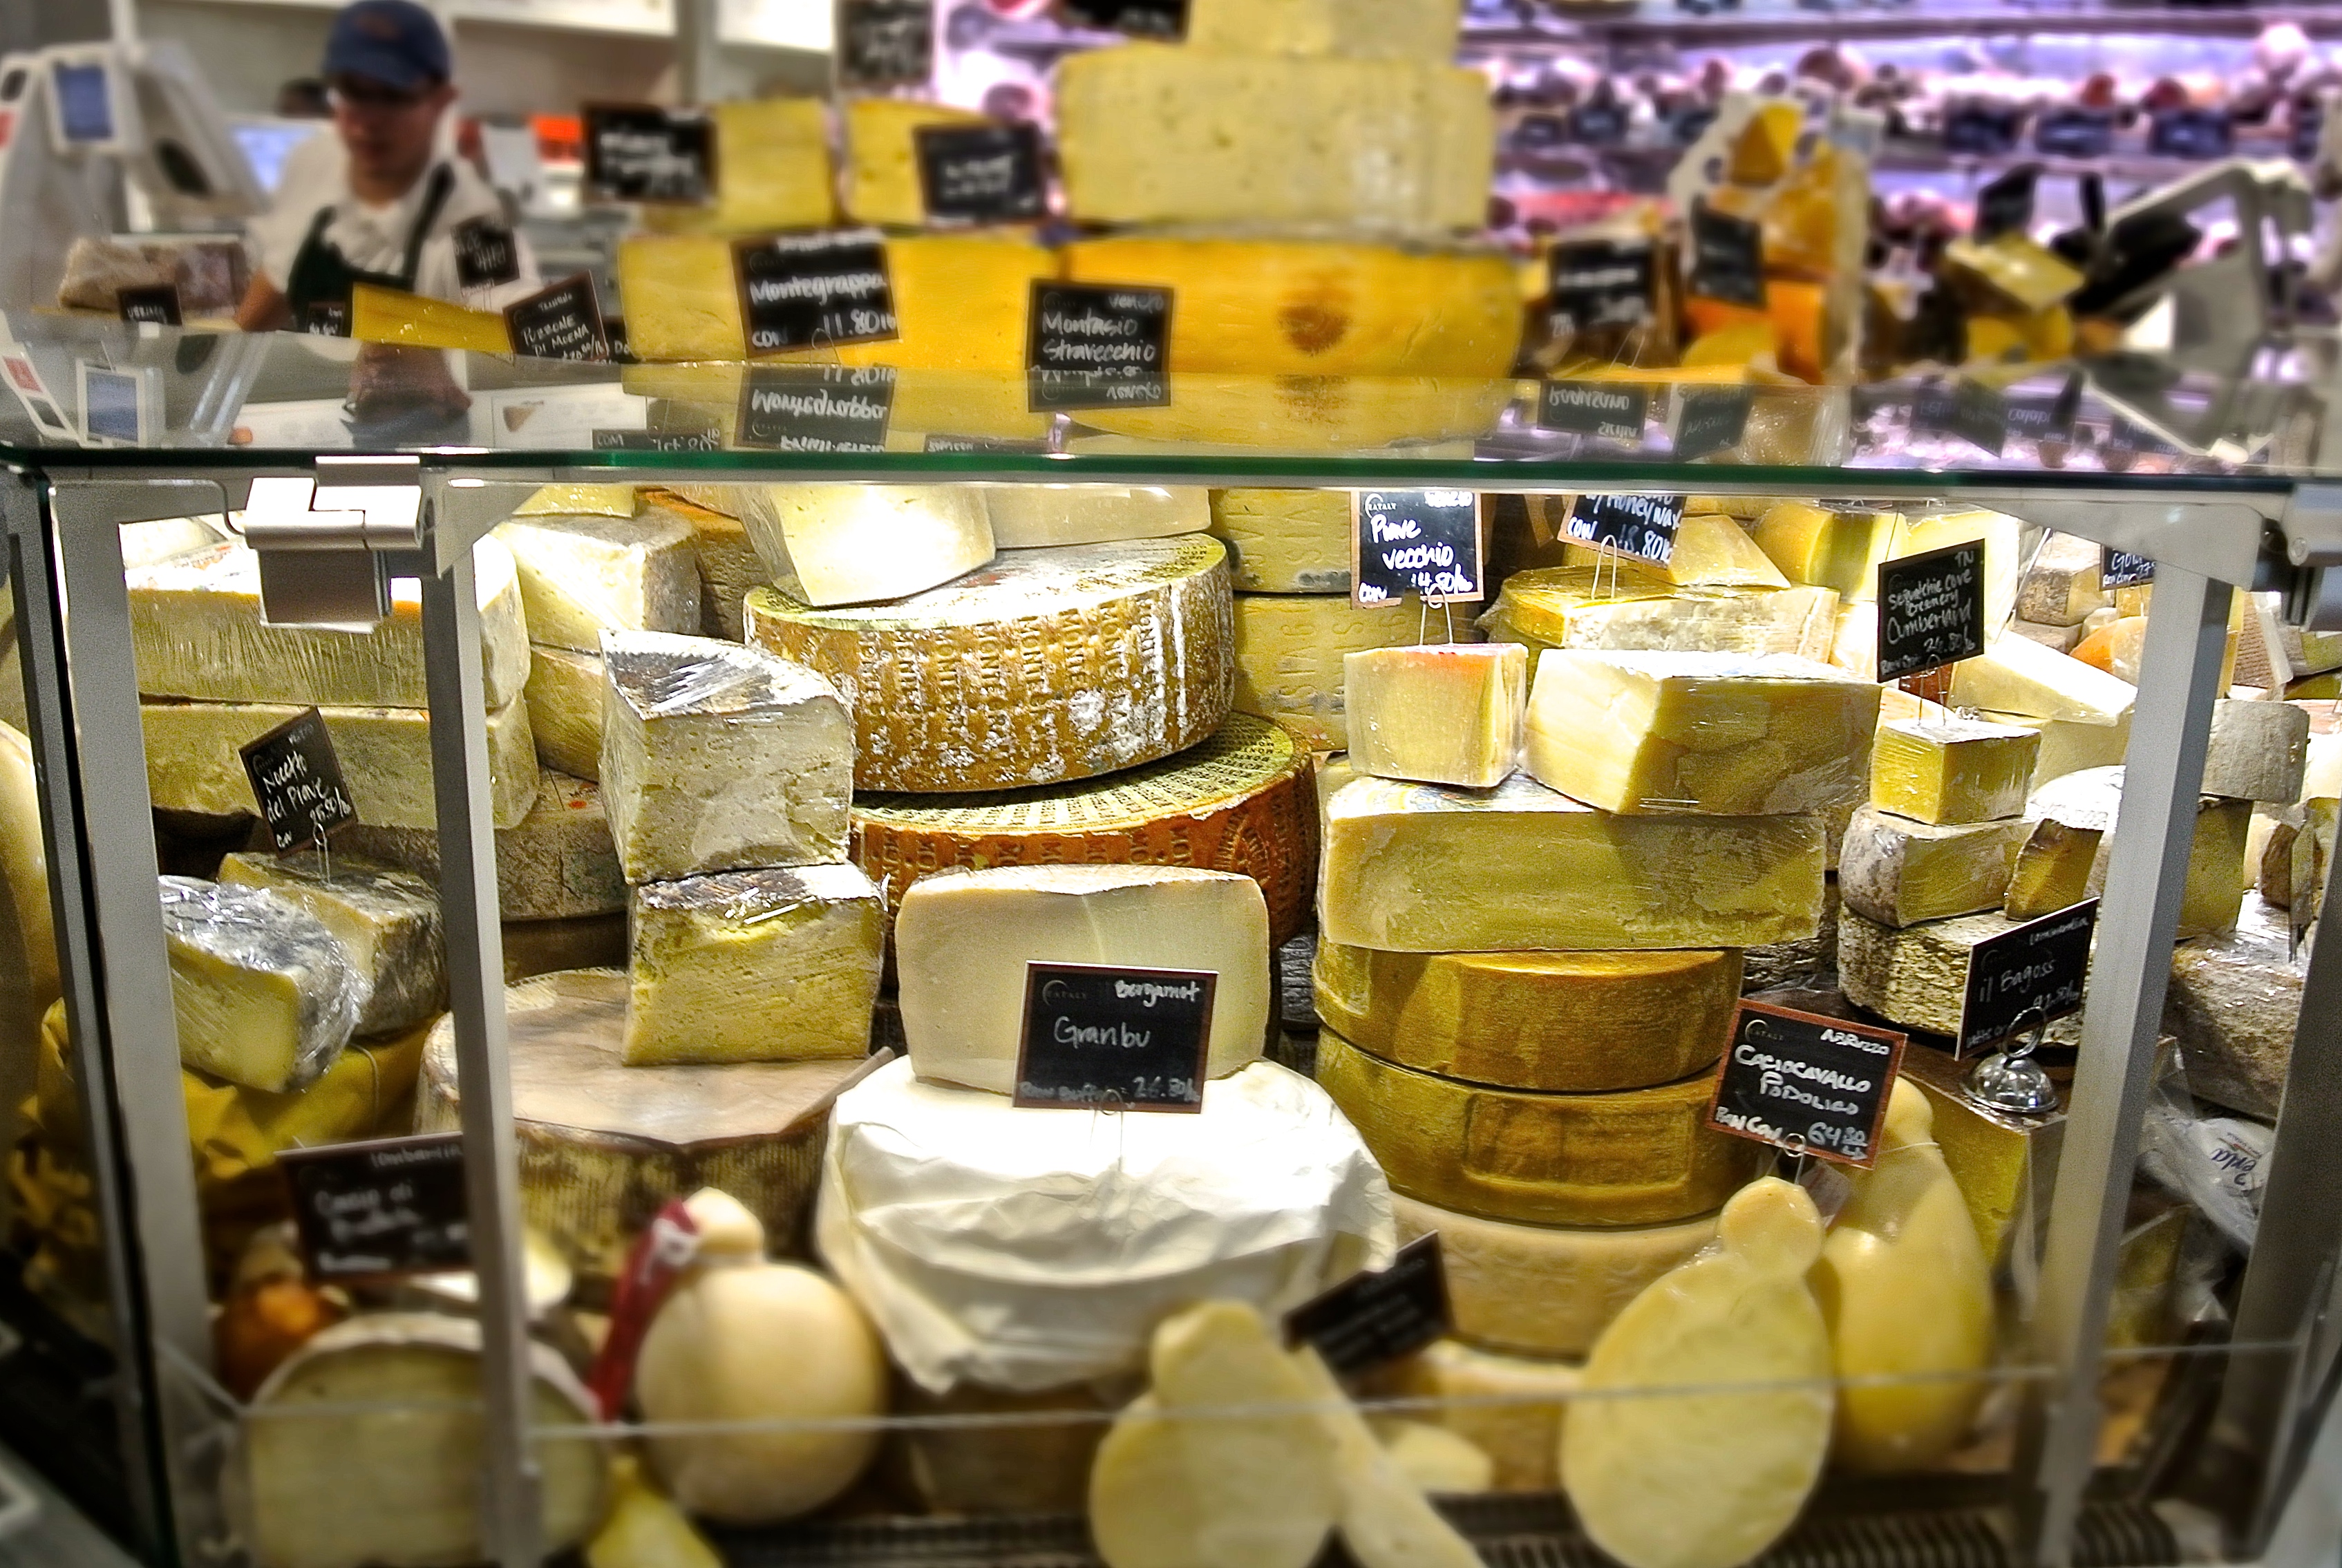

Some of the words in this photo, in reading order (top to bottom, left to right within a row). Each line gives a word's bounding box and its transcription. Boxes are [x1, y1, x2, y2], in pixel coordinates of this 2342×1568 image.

[749, 272, 887, 307] Montegrappa
[1041, 307, 1139, 337] Montasio
[1042, 338, 1157, 363] Stravecchio
[1567, 516, 1598, 540] COW
[1381, 541, 1454, 570] vecchio
[1114, 979, 1201, 1008] Bergamot
